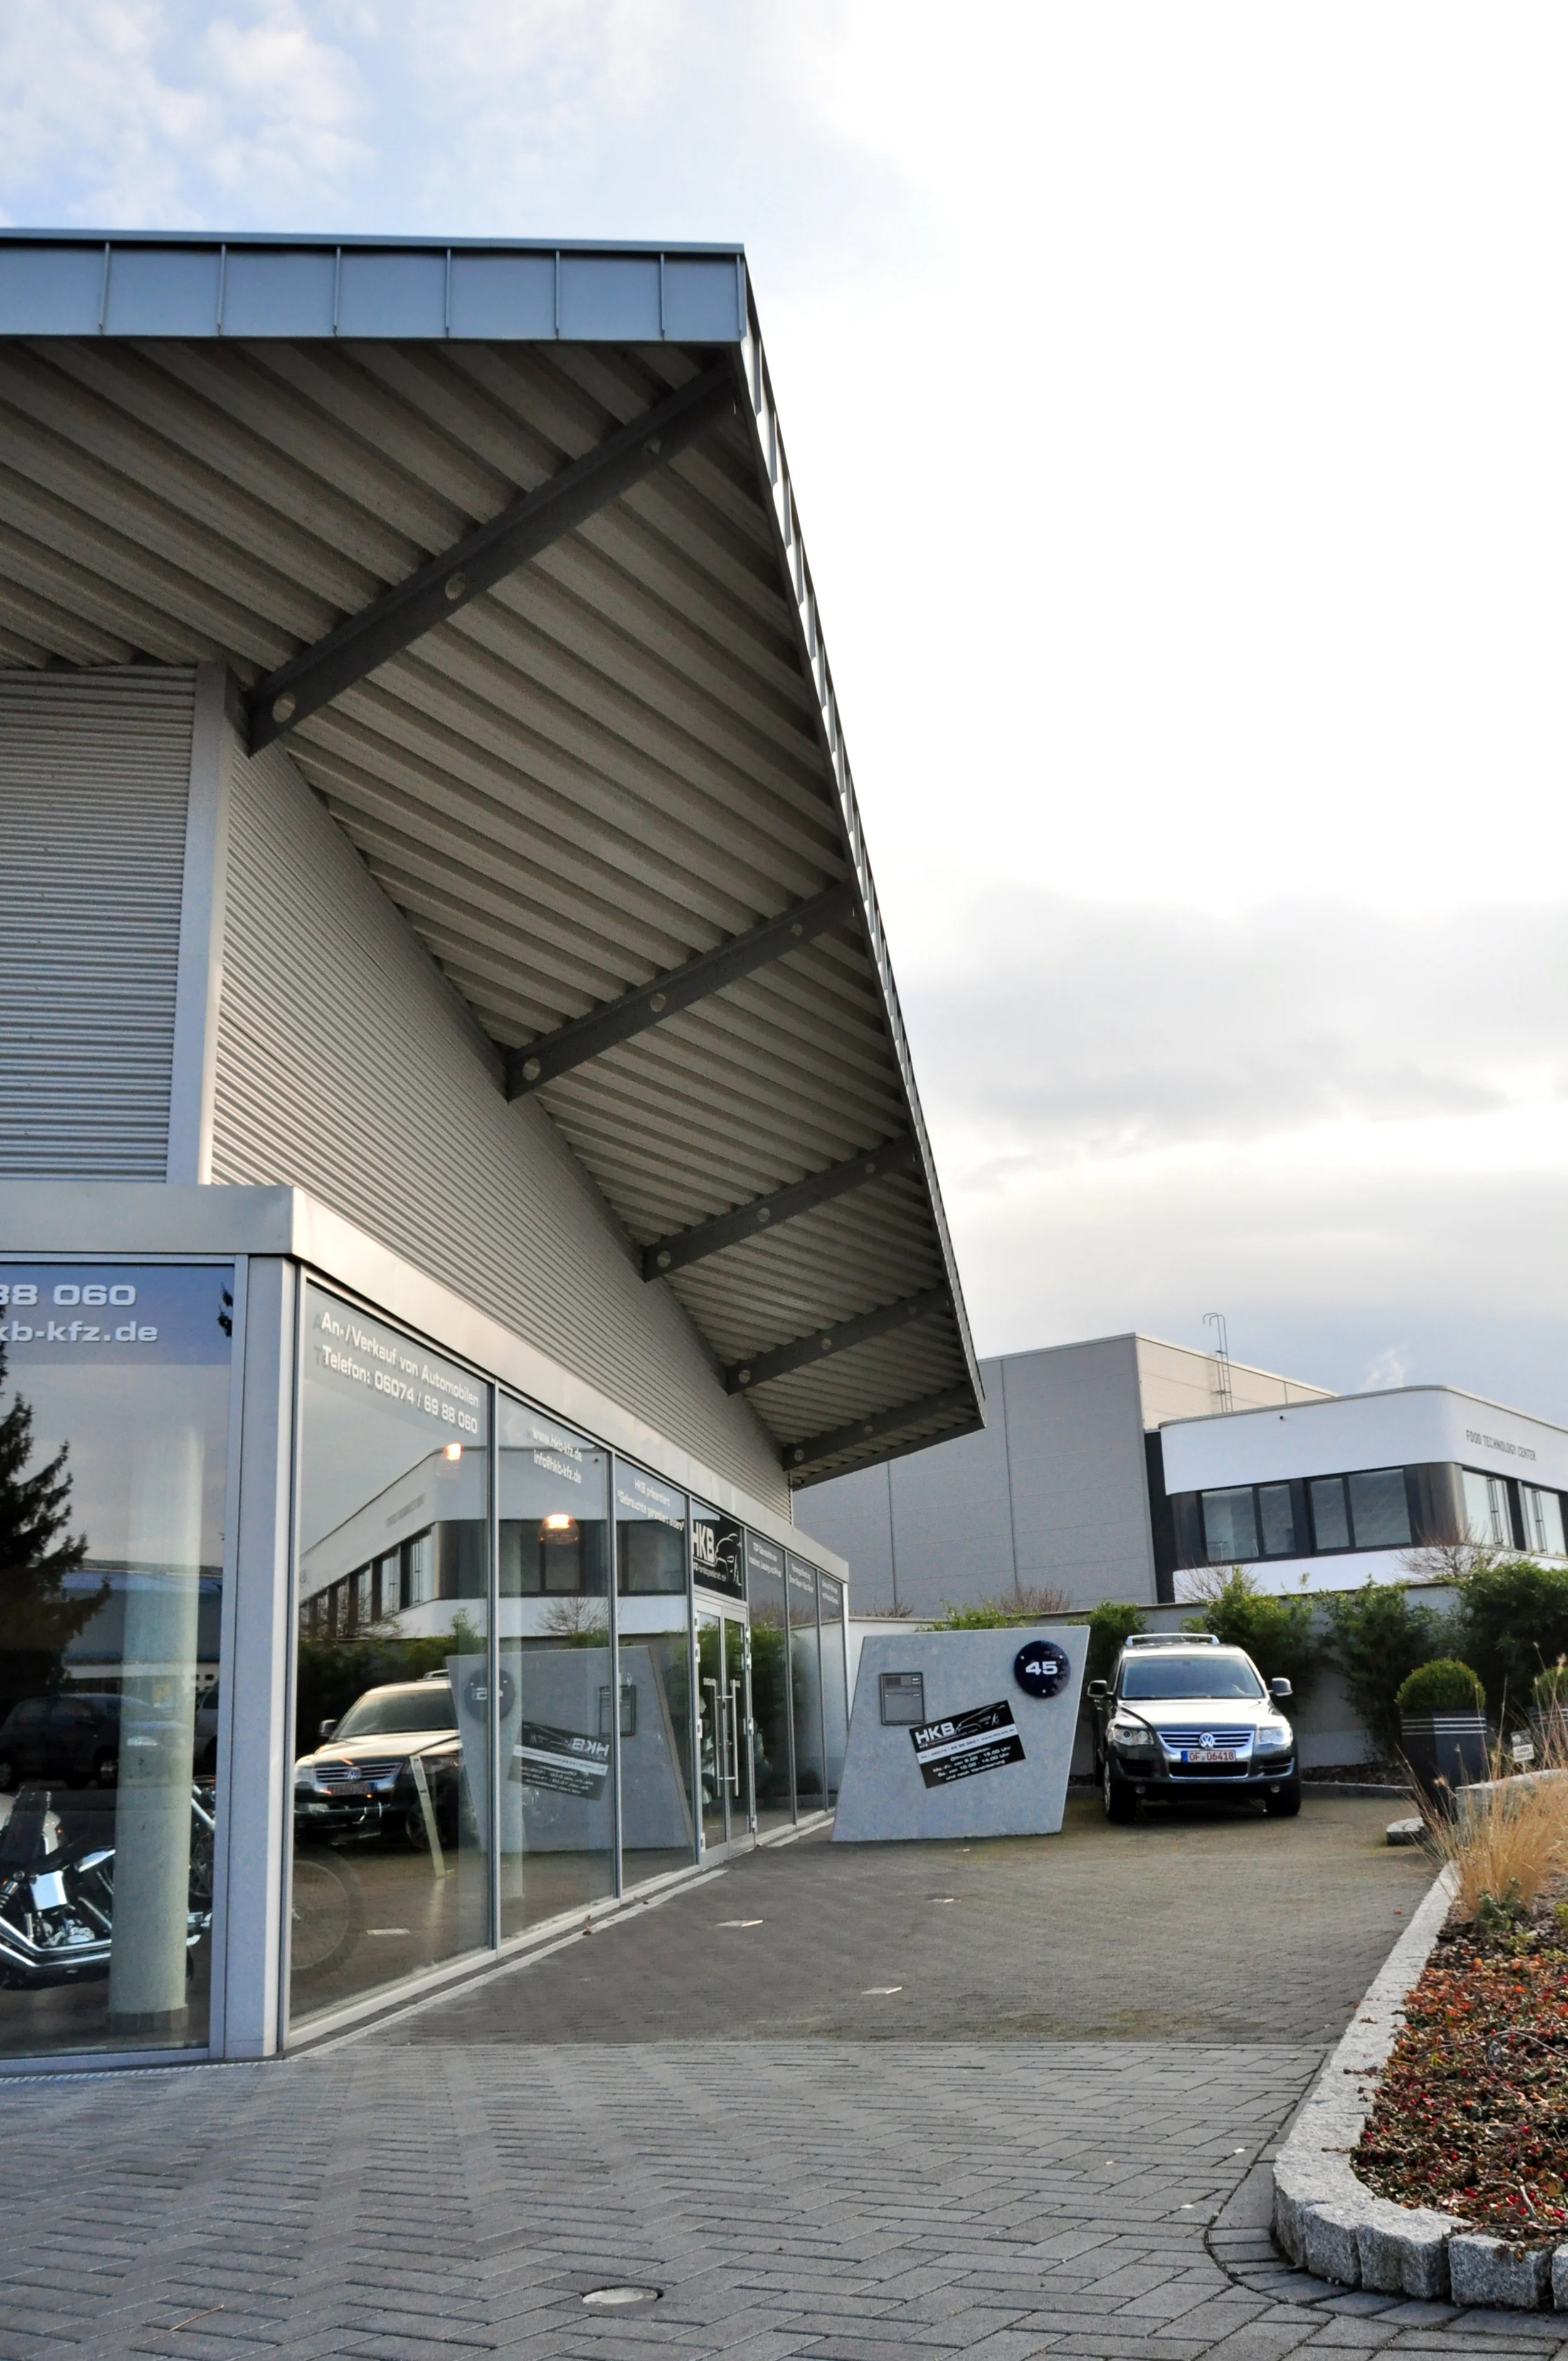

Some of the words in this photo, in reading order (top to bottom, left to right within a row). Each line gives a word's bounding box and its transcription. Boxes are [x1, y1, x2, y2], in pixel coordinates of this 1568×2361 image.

[53, 1284, 137, 1306] 060
[322, 1344, 370, 1384] Telefon:
[374, 1370, 415, 1405] 06074
[423, 1394, 439, 1416] 69
[442, 1403, 455, 1424] 88
[458, 1410, 478, 1434] 060
[400, 1356, 418, 1377] von
[421, 1364, 479, 1408] Automobilen
[1466, 1430, 1482, 1445] FOOD
[1483, 1435, 1517, 1455] TECHNOLOGY
[1518, 1445, 1536, 1462] CENTER
[691, 1519, 715, 1564] HKB
[1025, 1661, 1058, 1675] 45
[915, 1722, 955, 1744] HKB
[1189, 1752, 1201, 1761] OF
[1207, 1751, 1234, 1761] 06418
